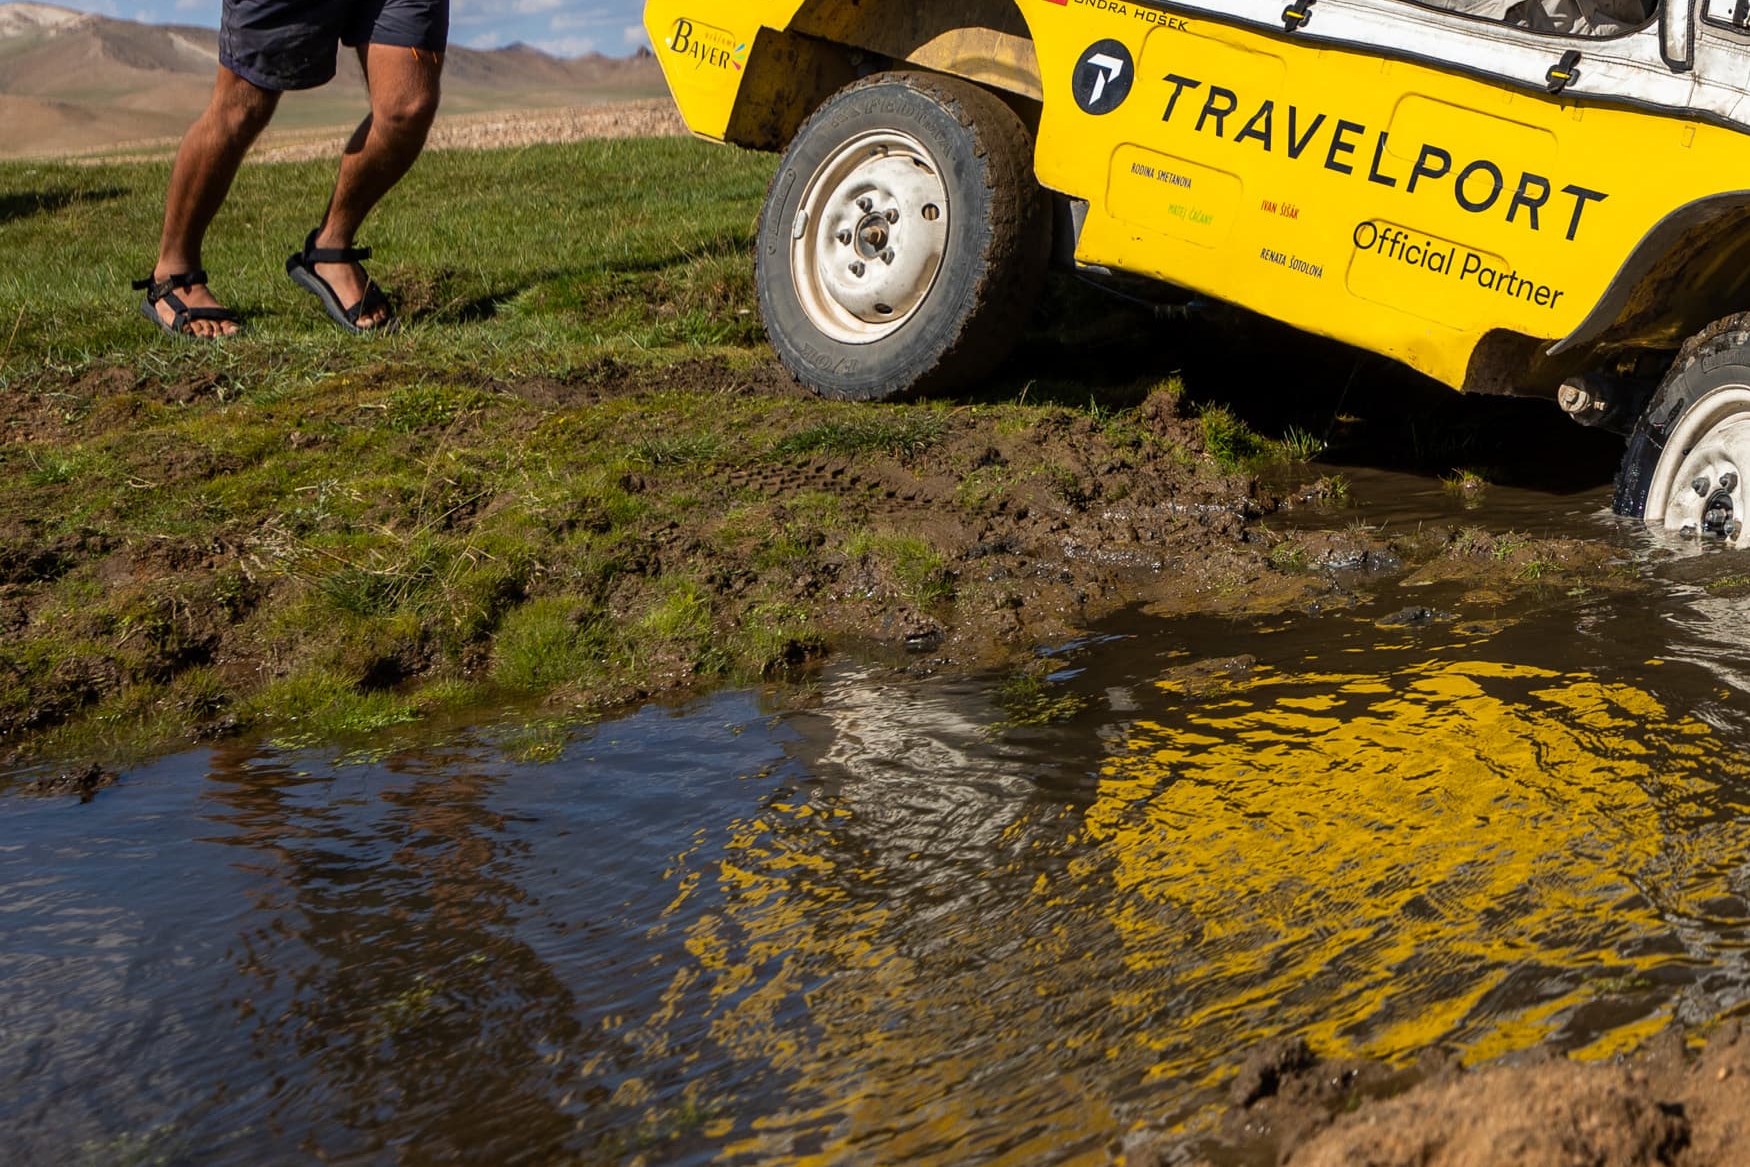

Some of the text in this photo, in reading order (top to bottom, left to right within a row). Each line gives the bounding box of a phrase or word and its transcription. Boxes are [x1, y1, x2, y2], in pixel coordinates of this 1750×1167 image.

[1134, 9, 1189, 32] HOŠEK
[1161, 72, 1609, 242] TRAVELPORT
[1260, 199, 1278, 215] IVAN
[1260, 247, 1286, 267] RENATA
[1352, 220, 1565, 311] Official Partner
